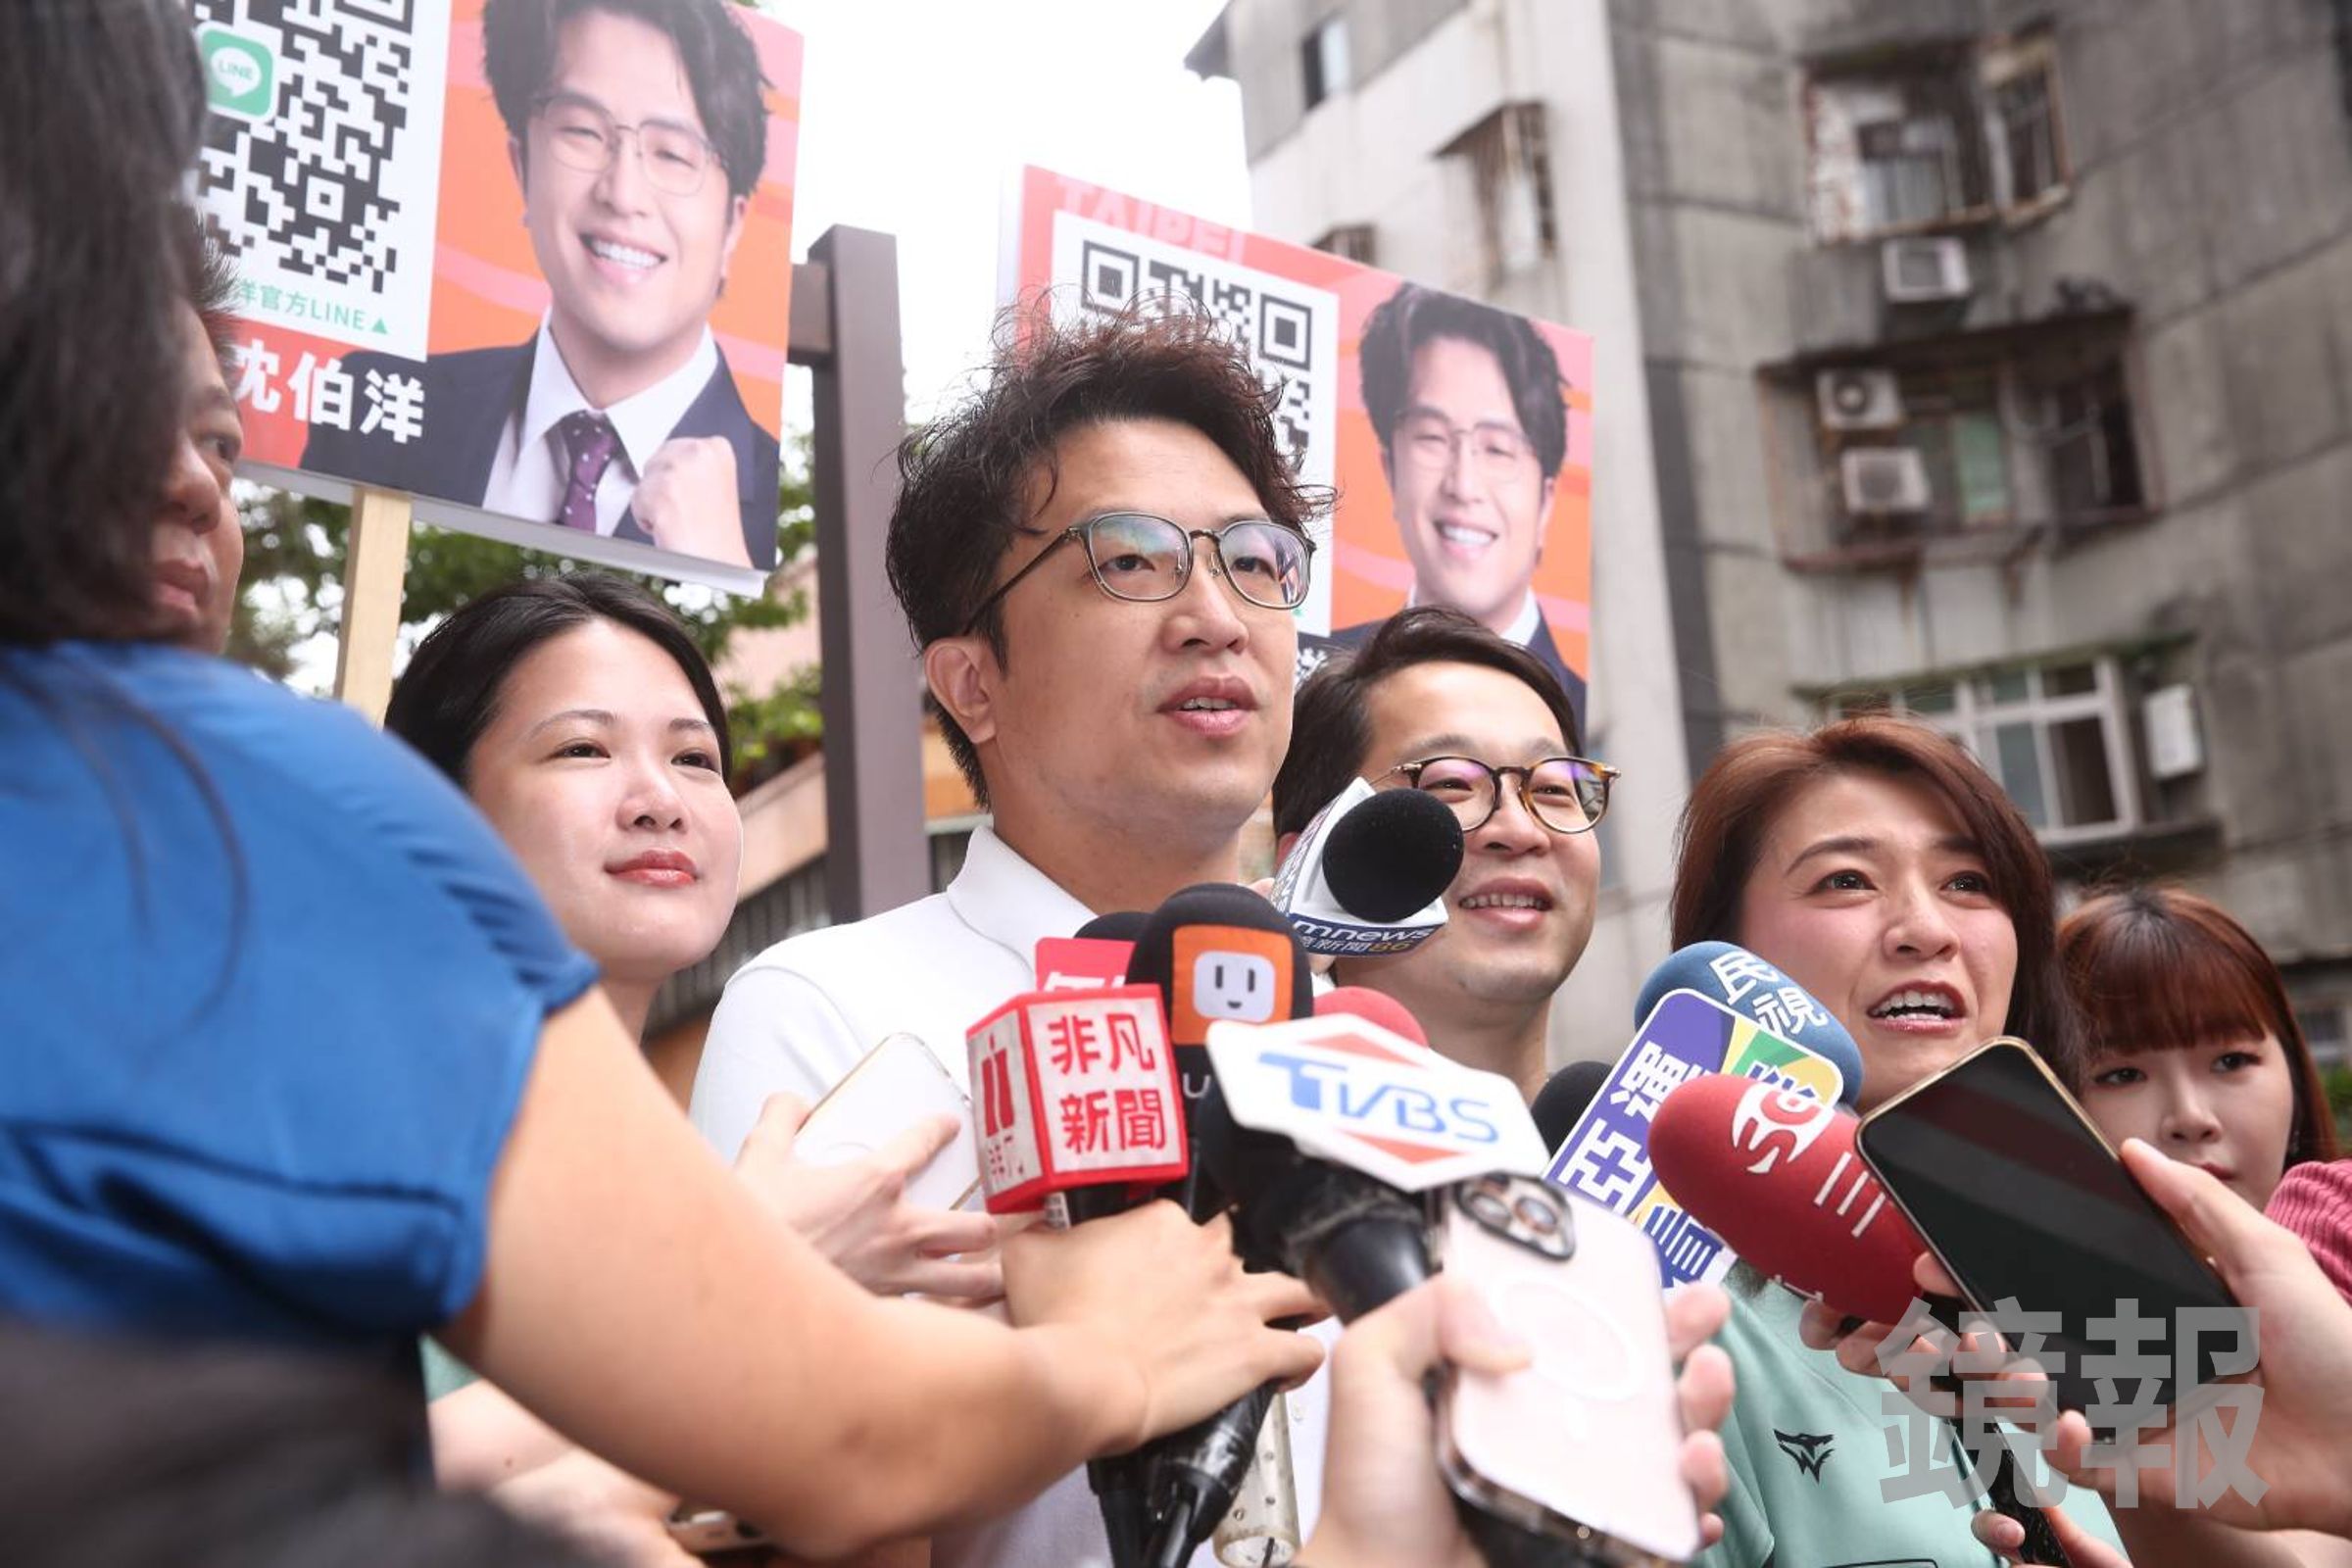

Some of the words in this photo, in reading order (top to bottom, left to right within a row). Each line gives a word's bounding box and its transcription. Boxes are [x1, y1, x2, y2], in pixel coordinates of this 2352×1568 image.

[219, 60, 253, 81] LINE
[1293, 919, 1435, 943] mnews
[1708, 951, 1830, 1036] 民視
[1048, 1013, 1156, 1075] 非凡
[1059, 1089, 1166, 1154] 新聞
[1257, 1052, 1499, 1144] TVBS
[1557, 1040, 1713, 1216] 亞運
